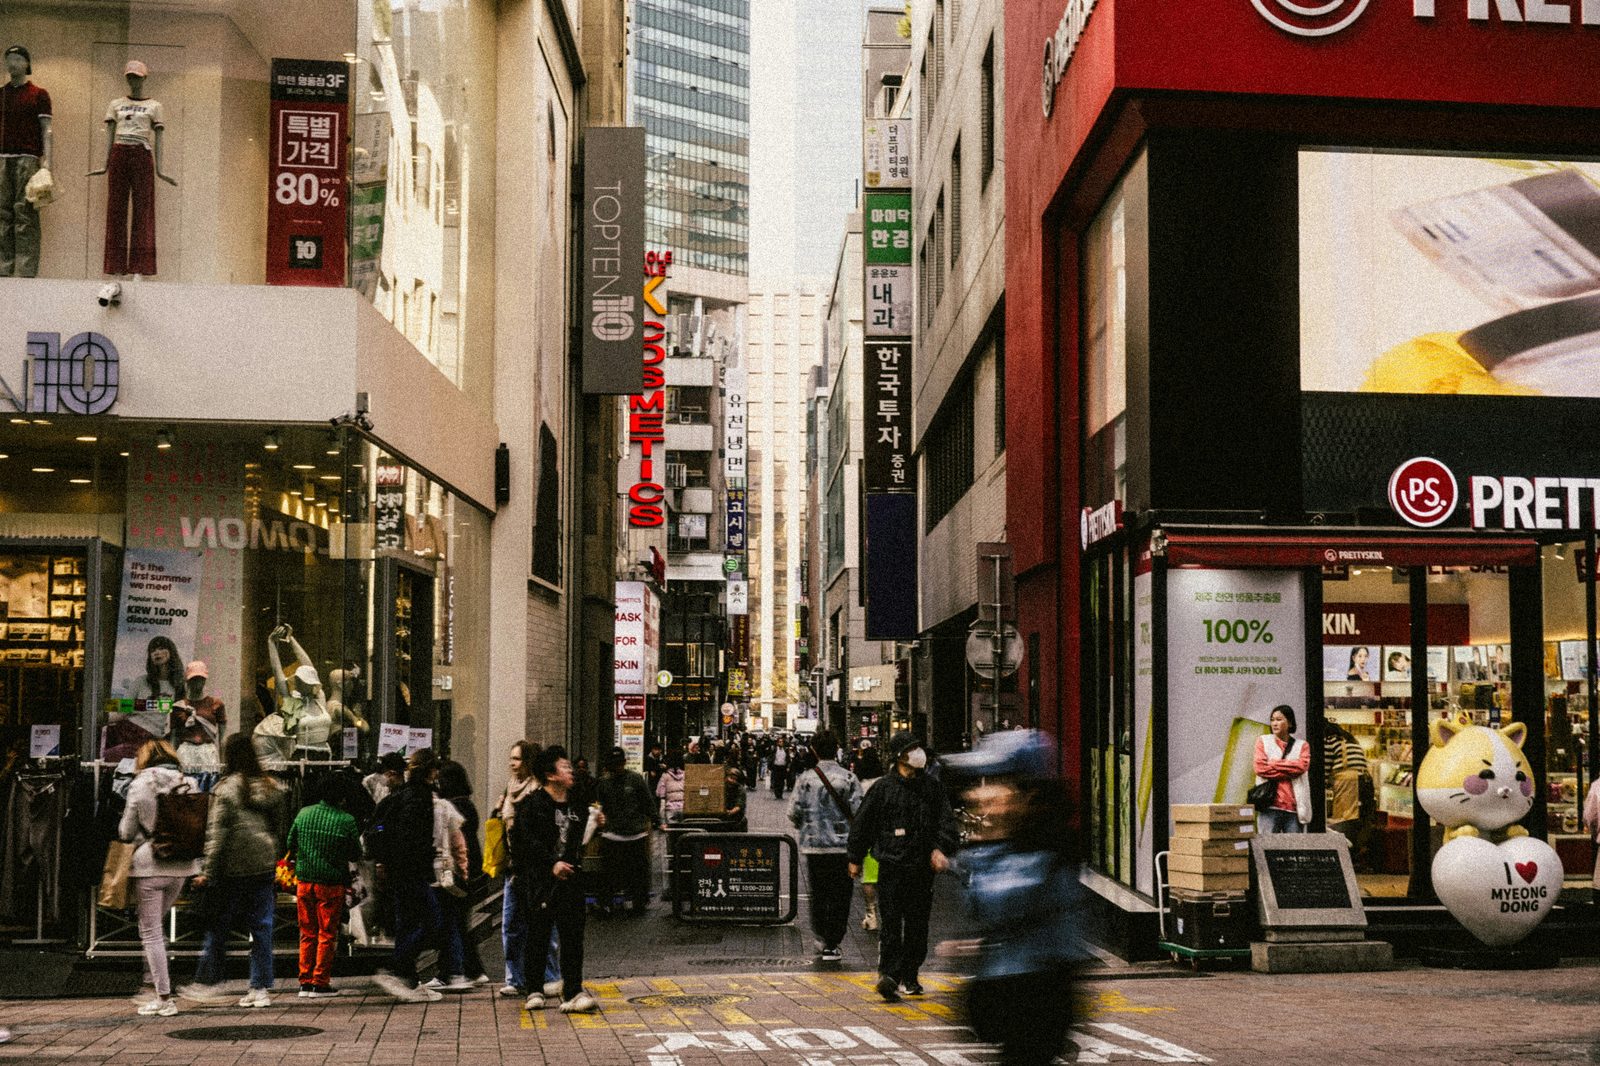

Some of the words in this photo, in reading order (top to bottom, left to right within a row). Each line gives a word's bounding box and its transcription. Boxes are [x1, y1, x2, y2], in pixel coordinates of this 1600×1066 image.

[326, 74, 345, 88] 3F
[287, 115, 330, 139] 특별
[286, 141, 330, 164] 가격
[871, 229, 909, 248] 안경
[295, 240, 317, 260] 10
[872, 283, 895, 328] 내과
[629, 320, 665, 527] COSMETICS
[877, 347, 902, 449] 한국투자
[890, 454, 905, 484] 증권
[728, 393, 743, 471] 유천냉면
[728, 502, 744, 547] 고시텔
[131, 562, 145, 571] It's
[148, 563, 165, 572] the
[130, 572, 148, 580] first
[150, 574, 192, 583] summer
[146, 583, 172, 591] meet
[127, 605, 151, 615] KRW
[154, 607, 188, 617] 10,000
[126, 615, 173, 626] discount
[1202, 618, 1273, 644] 100%
[615, 636, 637, 646] FOR
[614, 660, 639, 670] SKIN
[1252, 667, 1266, 675] 100
[617, 700, 627, 716] K
[1504, 862, 1513, 885] I
[1491, 886, 1547, 900] MYEONG
[1500, 900, 1539, 913] DONG
